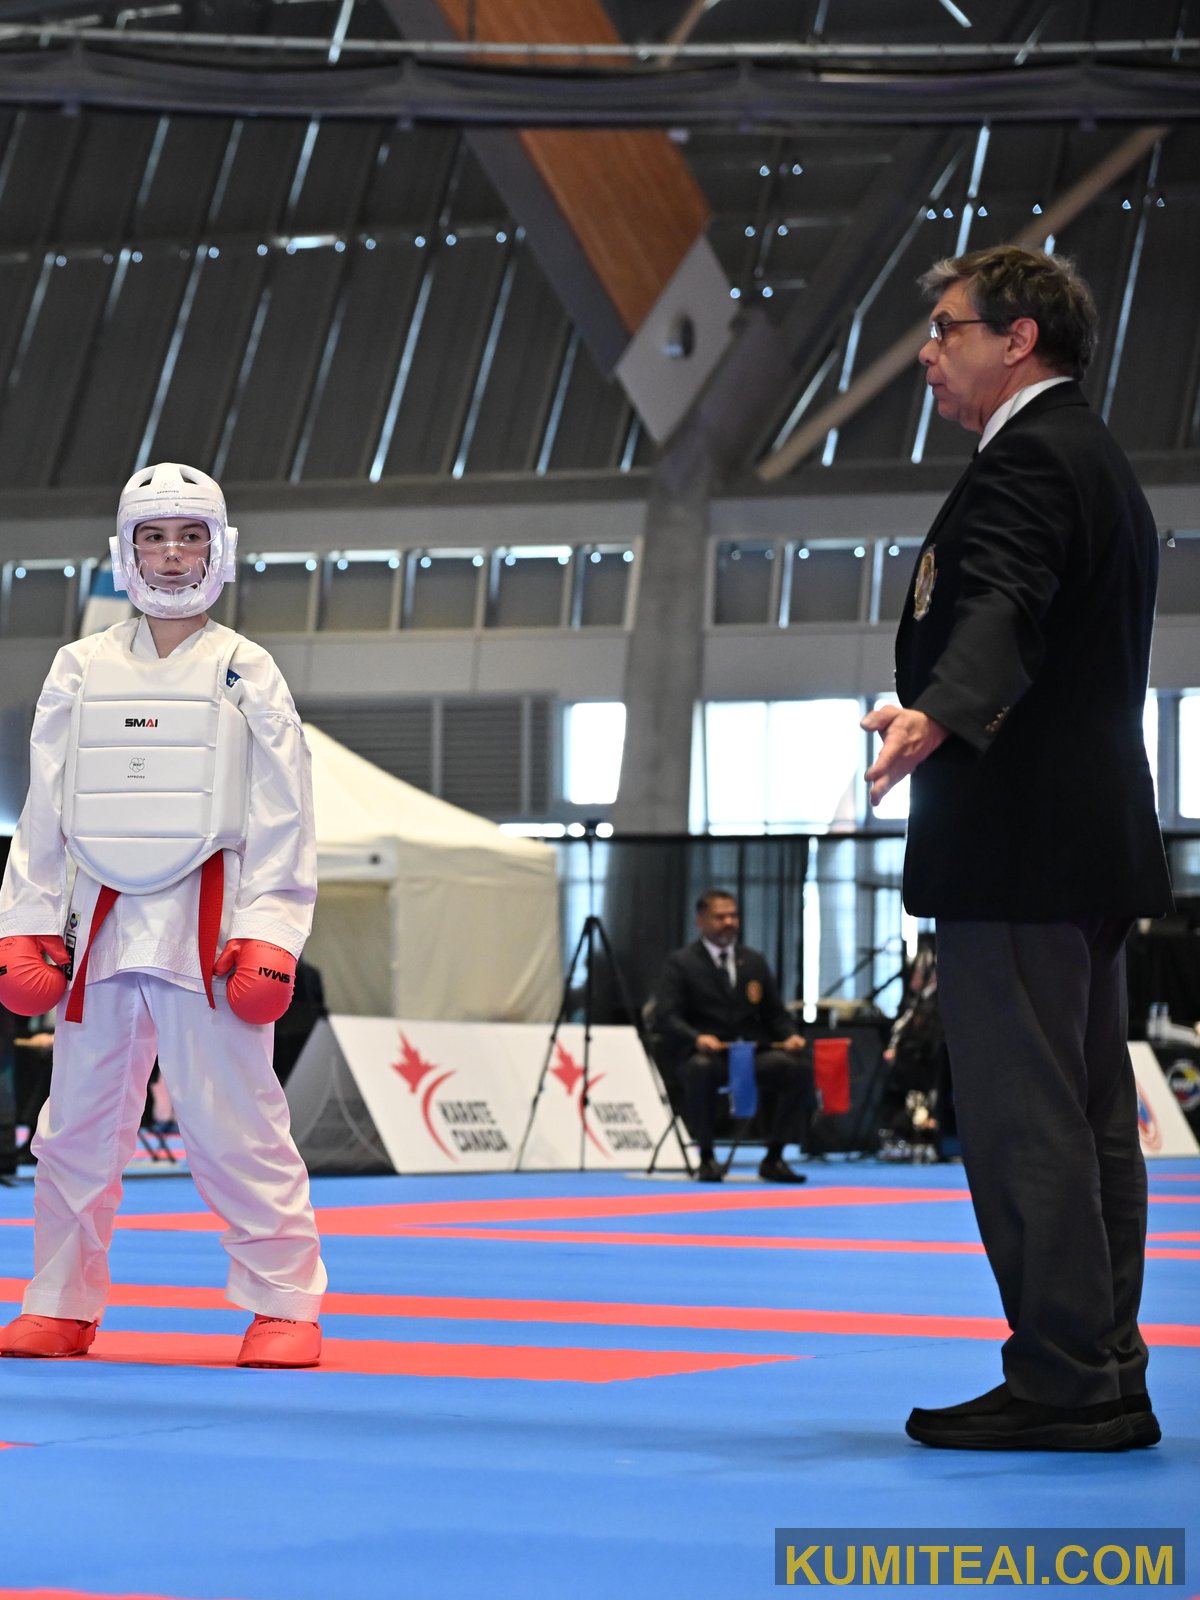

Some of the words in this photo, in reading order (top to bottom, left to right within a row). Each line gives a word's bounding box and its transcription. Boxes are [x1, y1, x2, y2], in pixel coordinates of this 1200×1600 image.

[124, 718, 159, 728] SMAI
[258, 966, 291, 984] SMAI
[438, 1101, 498, 1125] KARATE
[451, 1129, 511, 1152] CANADA
